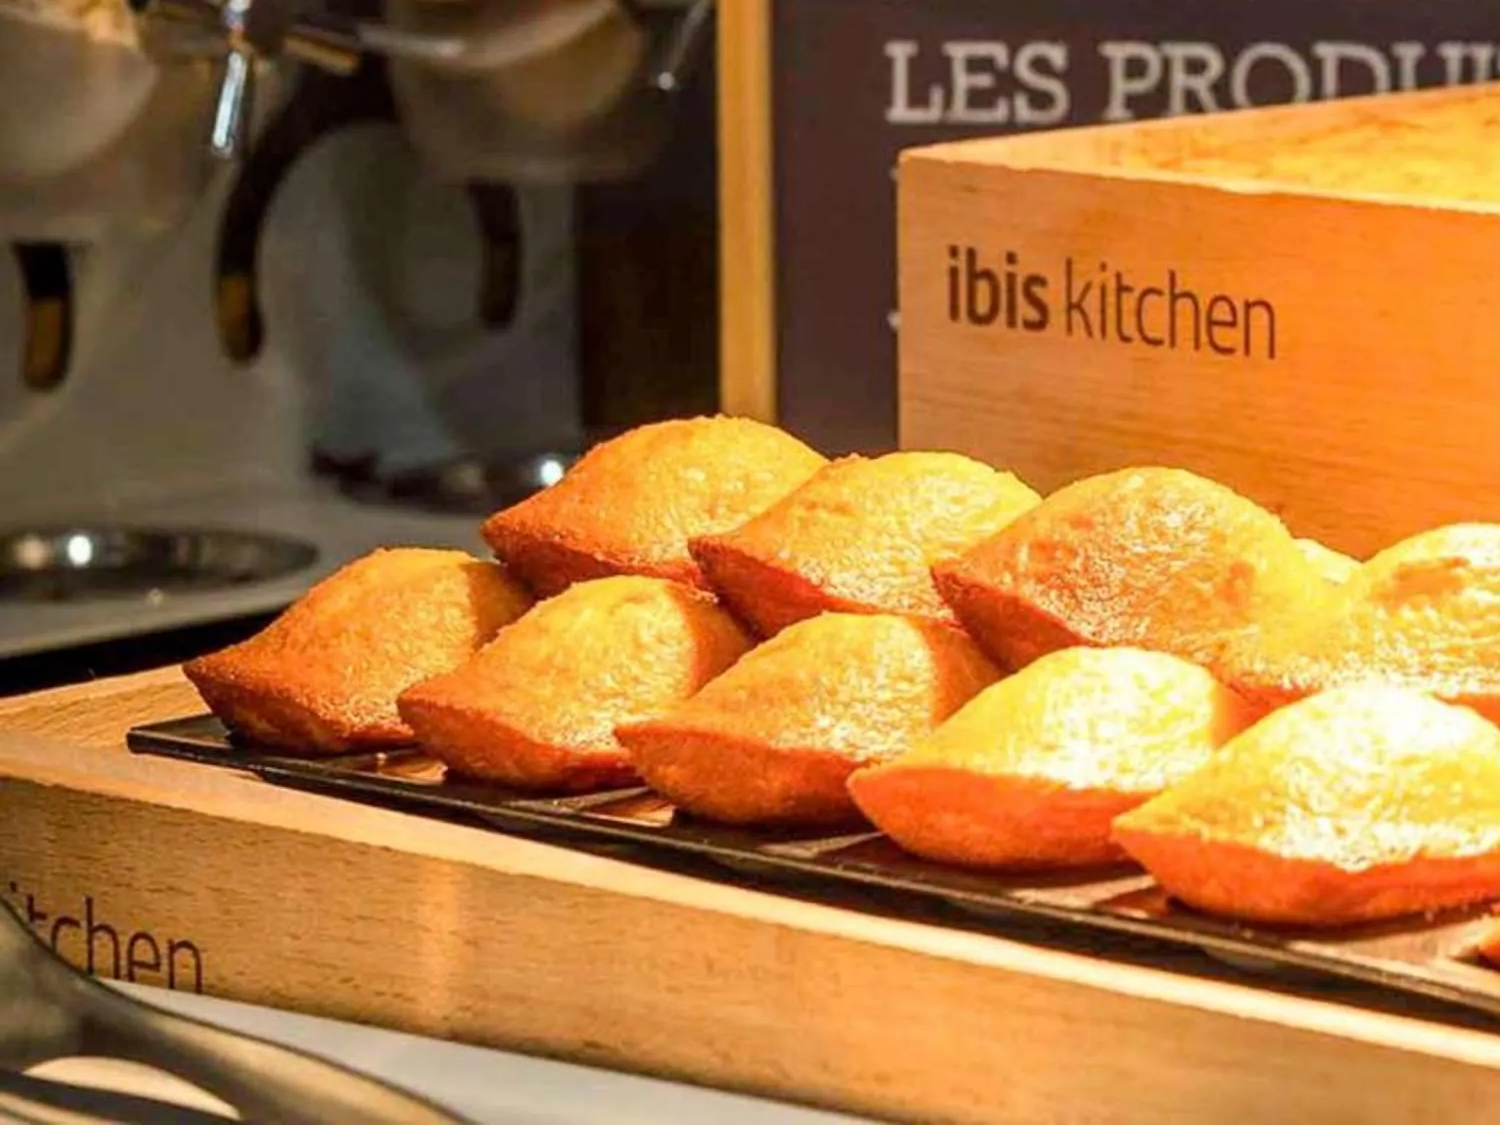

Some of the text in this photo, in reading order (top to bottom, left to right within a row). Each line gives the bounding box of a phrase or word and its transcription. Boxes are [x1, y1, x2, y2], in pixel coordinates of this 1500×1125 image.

[885, 42, 1070, 125] LES
[947, 244, 1276, 360] ibis kitchen
